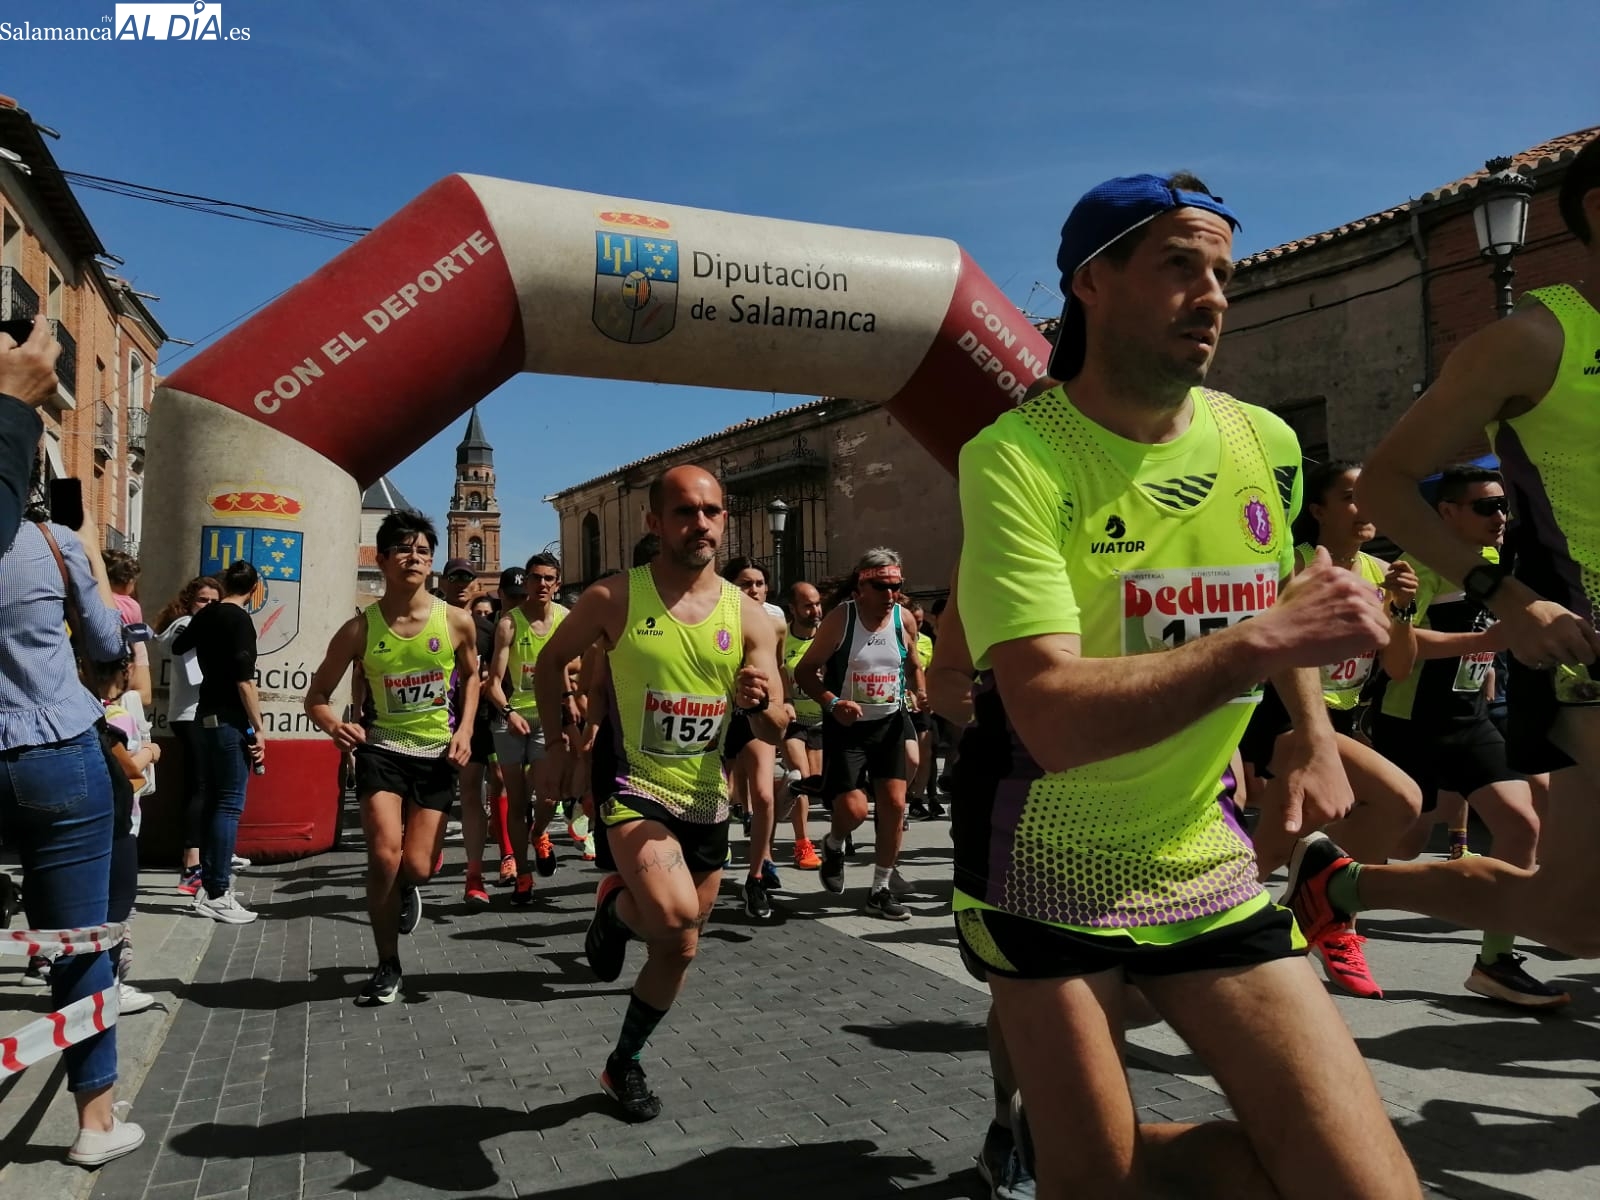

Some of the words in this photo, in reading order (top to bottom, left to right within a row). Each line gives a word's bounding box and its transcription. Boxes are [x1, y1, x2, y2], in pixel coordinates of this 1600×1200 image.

[692, 250, 849, 292] Diputación
[253, 357, 325, 415] CON
[320, 331, 367, 365] EL
[362, 230, 494, 334] DEPORTE
[690, 297, 717, 321] de
[729, 294, 876, 333] Salamanca
[971, 299, 1017, 349] CON
[1090, 539, 1146, 555] VIATOR
[1125, 573, 1276, 619] bedunia
[636, 629, 664, 637] VIATOR
[383, 671, 444, 688] bedunia
[853, 672, 896, 683] bedunia
[1331, 659, 1357, 680] 20
[397, 683, 435, 705] 174
[866, 683, 885, 697] 54
[661, 716, 714, 742] 152
